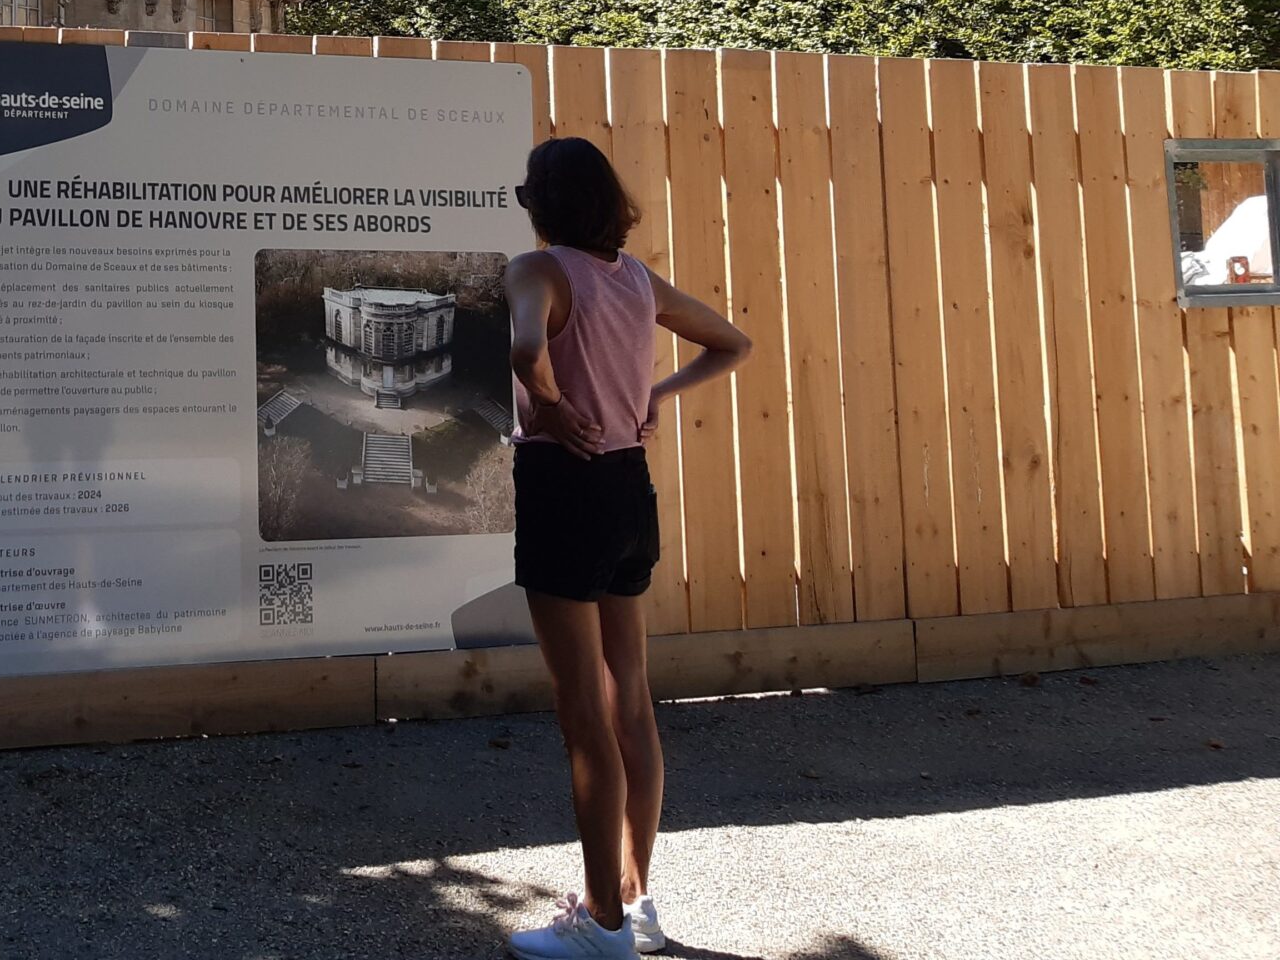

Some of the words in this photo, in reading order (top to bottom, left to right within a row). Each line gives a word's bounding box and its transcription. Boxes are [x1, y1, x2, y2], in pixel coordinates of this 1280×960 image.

[4, 108, 68, 120] DÉPARTEMENT
[148, 98, 236, 114] DOMAINE
[244, 99, 399, 121] DÉPARTEMENTAL
[407, 107, 429, 122] DE
[438, 108, 506, 124] SCEAUX
[8, 178, 50, 199] UNE
[56, 175, 216, 202] RÉHABILITATION
[222, 184, 275, 204] POUR
[280, 180, 388, 206] AMÉLIORER
[394, 186, 416, 206] LA
[419, 184, 508, 209] VISIBILITÉ
[10, 208, 110, 228] PAVILLON
[117, 209, 144, 229] DE
[150, 210, 247, 230] HANOVRE
[254, 212, 276, 230] ET
[282, 212, 308, 231] DE
[313, 213, 348, 232] SES
[354, 214, 432, 234] ABORDS
[16, 246, 50, 256] intègre
[52, 246, 66, 255] les
[70, 247, 114, 255] nouveaux
[117, 247, 152, 256] besoins
[155, 247, 197, 258] exprimés
[200, 248, 220, 258] pour
[222, 248, 230, 256] la
[31, 262, 42, 271] du
[46, 262, 87, 271] Domaine
[90, 263, 101, 271] de
[104, 263, 136, 272] Sceaux
[139, 264, 148, 272] et
[151, 263, 162, 272] de
[164, 264, 179, 272] ses
[62, 283, 78, 291] des
[85, 284, 130, 292] sanitaires
[136, 284, 169, 294] publics
[175, 284, 233, 292] actuellement
[28, 299, 86, 310] rez-de-jardin
[90, 300, 102, 308] du
[106, 300, 142, 310] pavillon
[162, 300, 180, 308] sein
[184, 300, 195, 308] du
[199, 300, 233, 310] kiosque
[50, 334, 62, 343] de
[64, 334, 73, 343] la
[75, 334, 106, 345] façade
[108, 334, 142, 342] inscrite
[156, 334, 167, 342] de
[170, 334, 216, 342] l'ensemble
[218, 334, 234, 342] des
[60, 370, 124, 378] architecturale
[127, 370, 136, 378] et
[139, 369, 184, 380] technique
[187, 369, 198, 378] du
[202, 369, 236, 379] pavillon
[0, 387, 12, 396] de
[14, 387, 60, 398] permettre
[74, 406, 120, 416] paysagers
[123, 405, 139, 414] des
[142, 406, 179, 415] espaces
[182, 404, 226, 413] entourant
[229, 404, 237, 412] le
[62, 472, 146, 482] PRÉVISIONNEL
[15, 492, 32, 501] des
[78, 490, 102, 500] 2024
[2, 506, 41, 516] estimée
[44, 506, 60, 514] des
[106, 504, 129, 513] 2026
[26, 567, 75, 577] d'ouvrage
[49, 581, 66, 590] des
[69, 578, 142, 590] Hauts-de-Seine
[96, 612, 151, 622] architectes
[156, 610, 168, 618] du
[174, 608, 226, 620] patrimoine
[37, 630, 77, 640] l'agence
[81, 628, 92, 637] de
